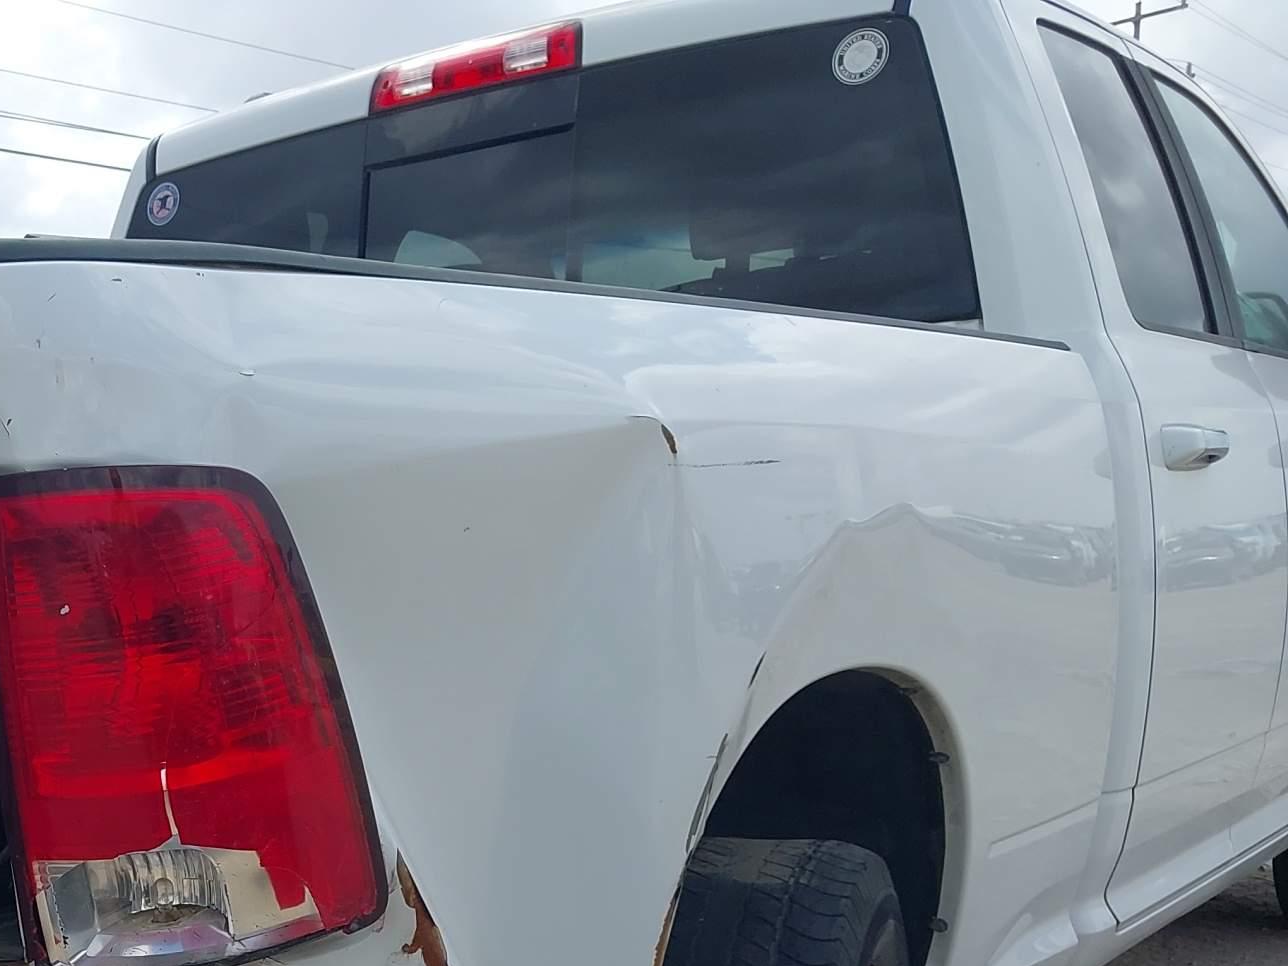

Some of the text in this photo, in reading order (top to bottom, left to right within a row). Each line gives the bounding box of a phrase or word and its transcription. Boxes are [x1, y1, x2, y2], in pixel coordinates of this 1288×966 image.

[839, 35, 863, 56] UNITED
[839, 58, 881, 80] MARINE CORPS
